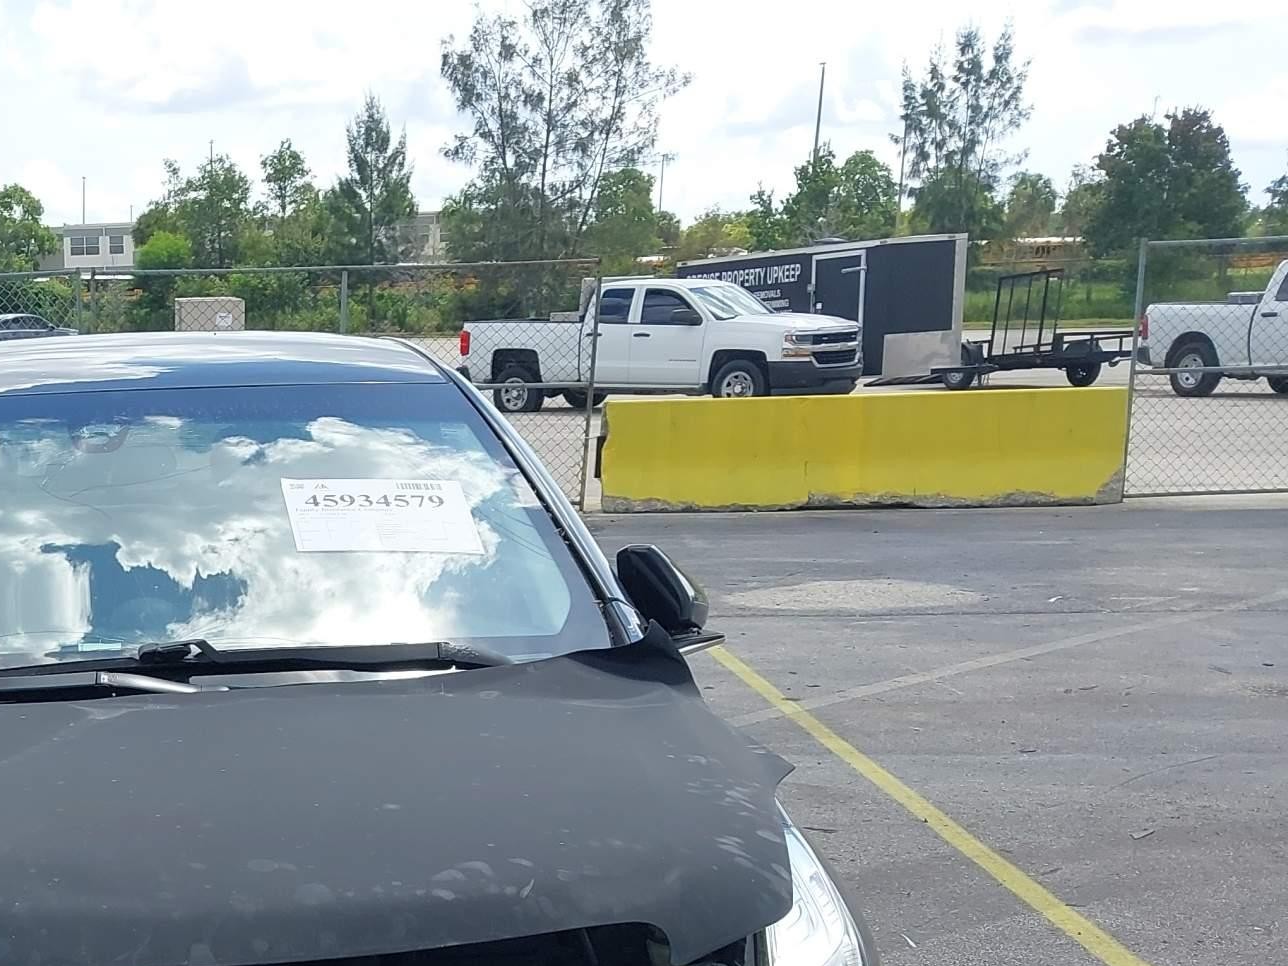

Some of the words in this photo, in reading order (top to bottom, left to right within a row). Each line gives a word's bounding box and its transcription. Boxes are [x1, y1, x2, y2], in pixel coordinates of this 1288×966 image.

[722, 267, 766, 287] PROPERTY
[767, 263, 801, 285] UPKEEP
[305, 494, 444, 508] 45934579
